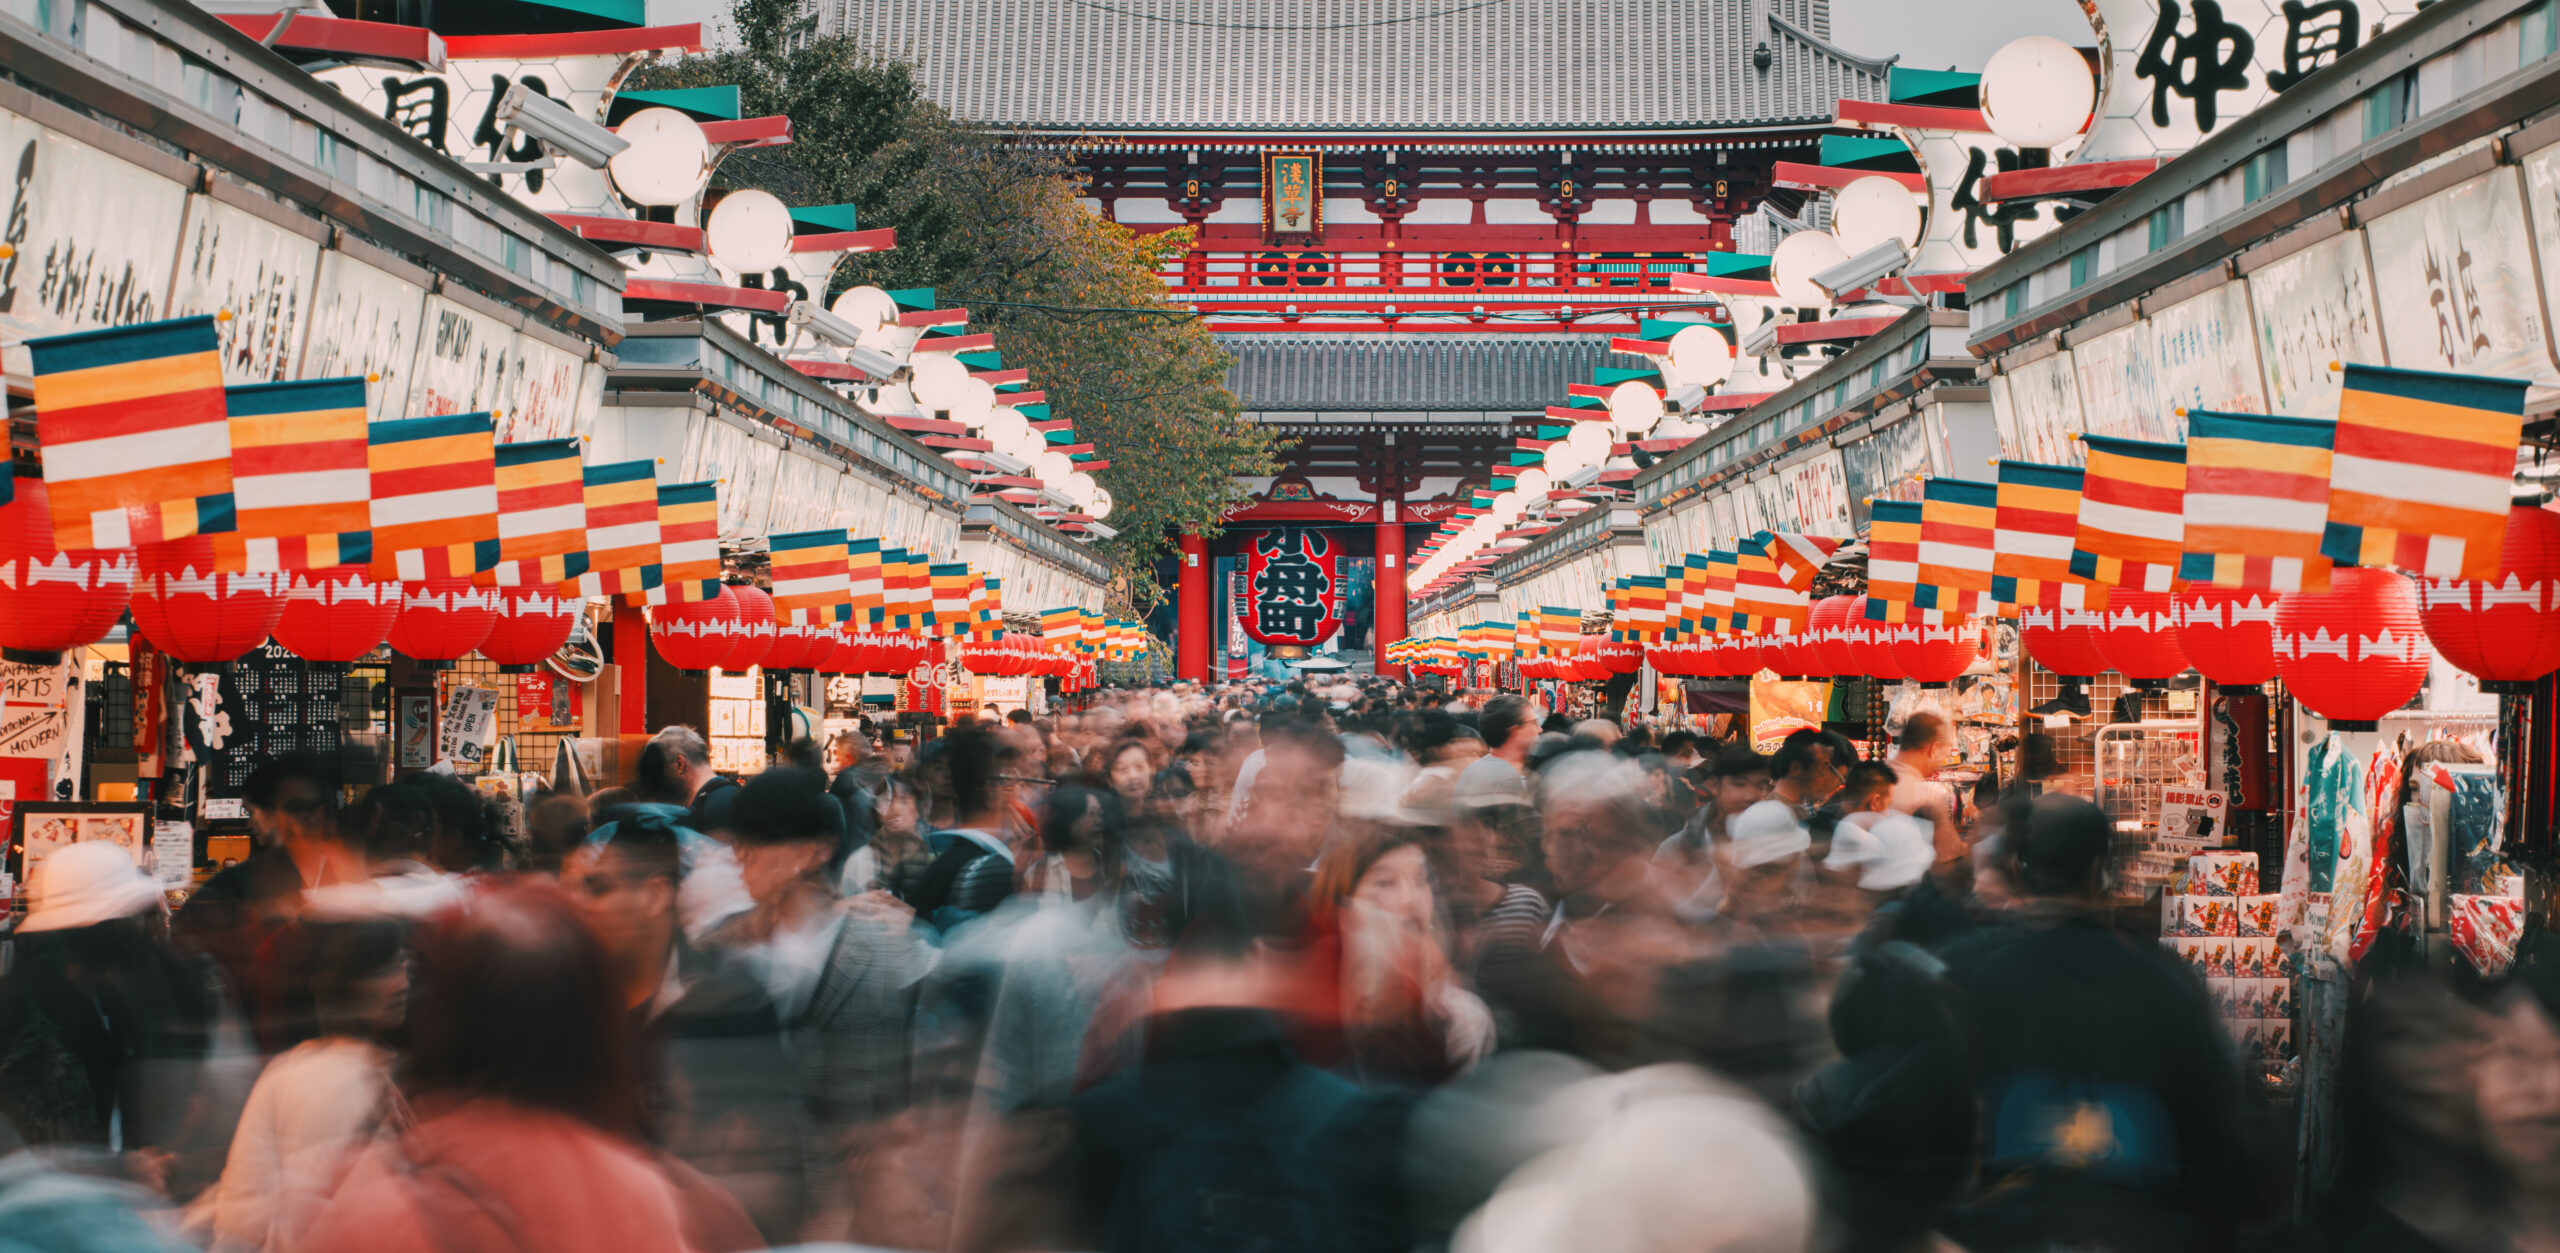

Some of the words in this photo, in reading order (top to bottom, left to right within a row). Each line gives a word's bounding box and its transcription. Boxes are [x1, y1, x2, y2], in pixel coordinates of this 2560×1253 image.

[1254, 528, 1329, 641] 小舟町
[6, 677, 53, 698] ARTS
[463, 713, 478, 732] OPEN
[10, 722, 60, 755] MODERN
[1756, 741, 1784, 753] ウラの
[2165, 791, 2205, 806] 撮影禁止
